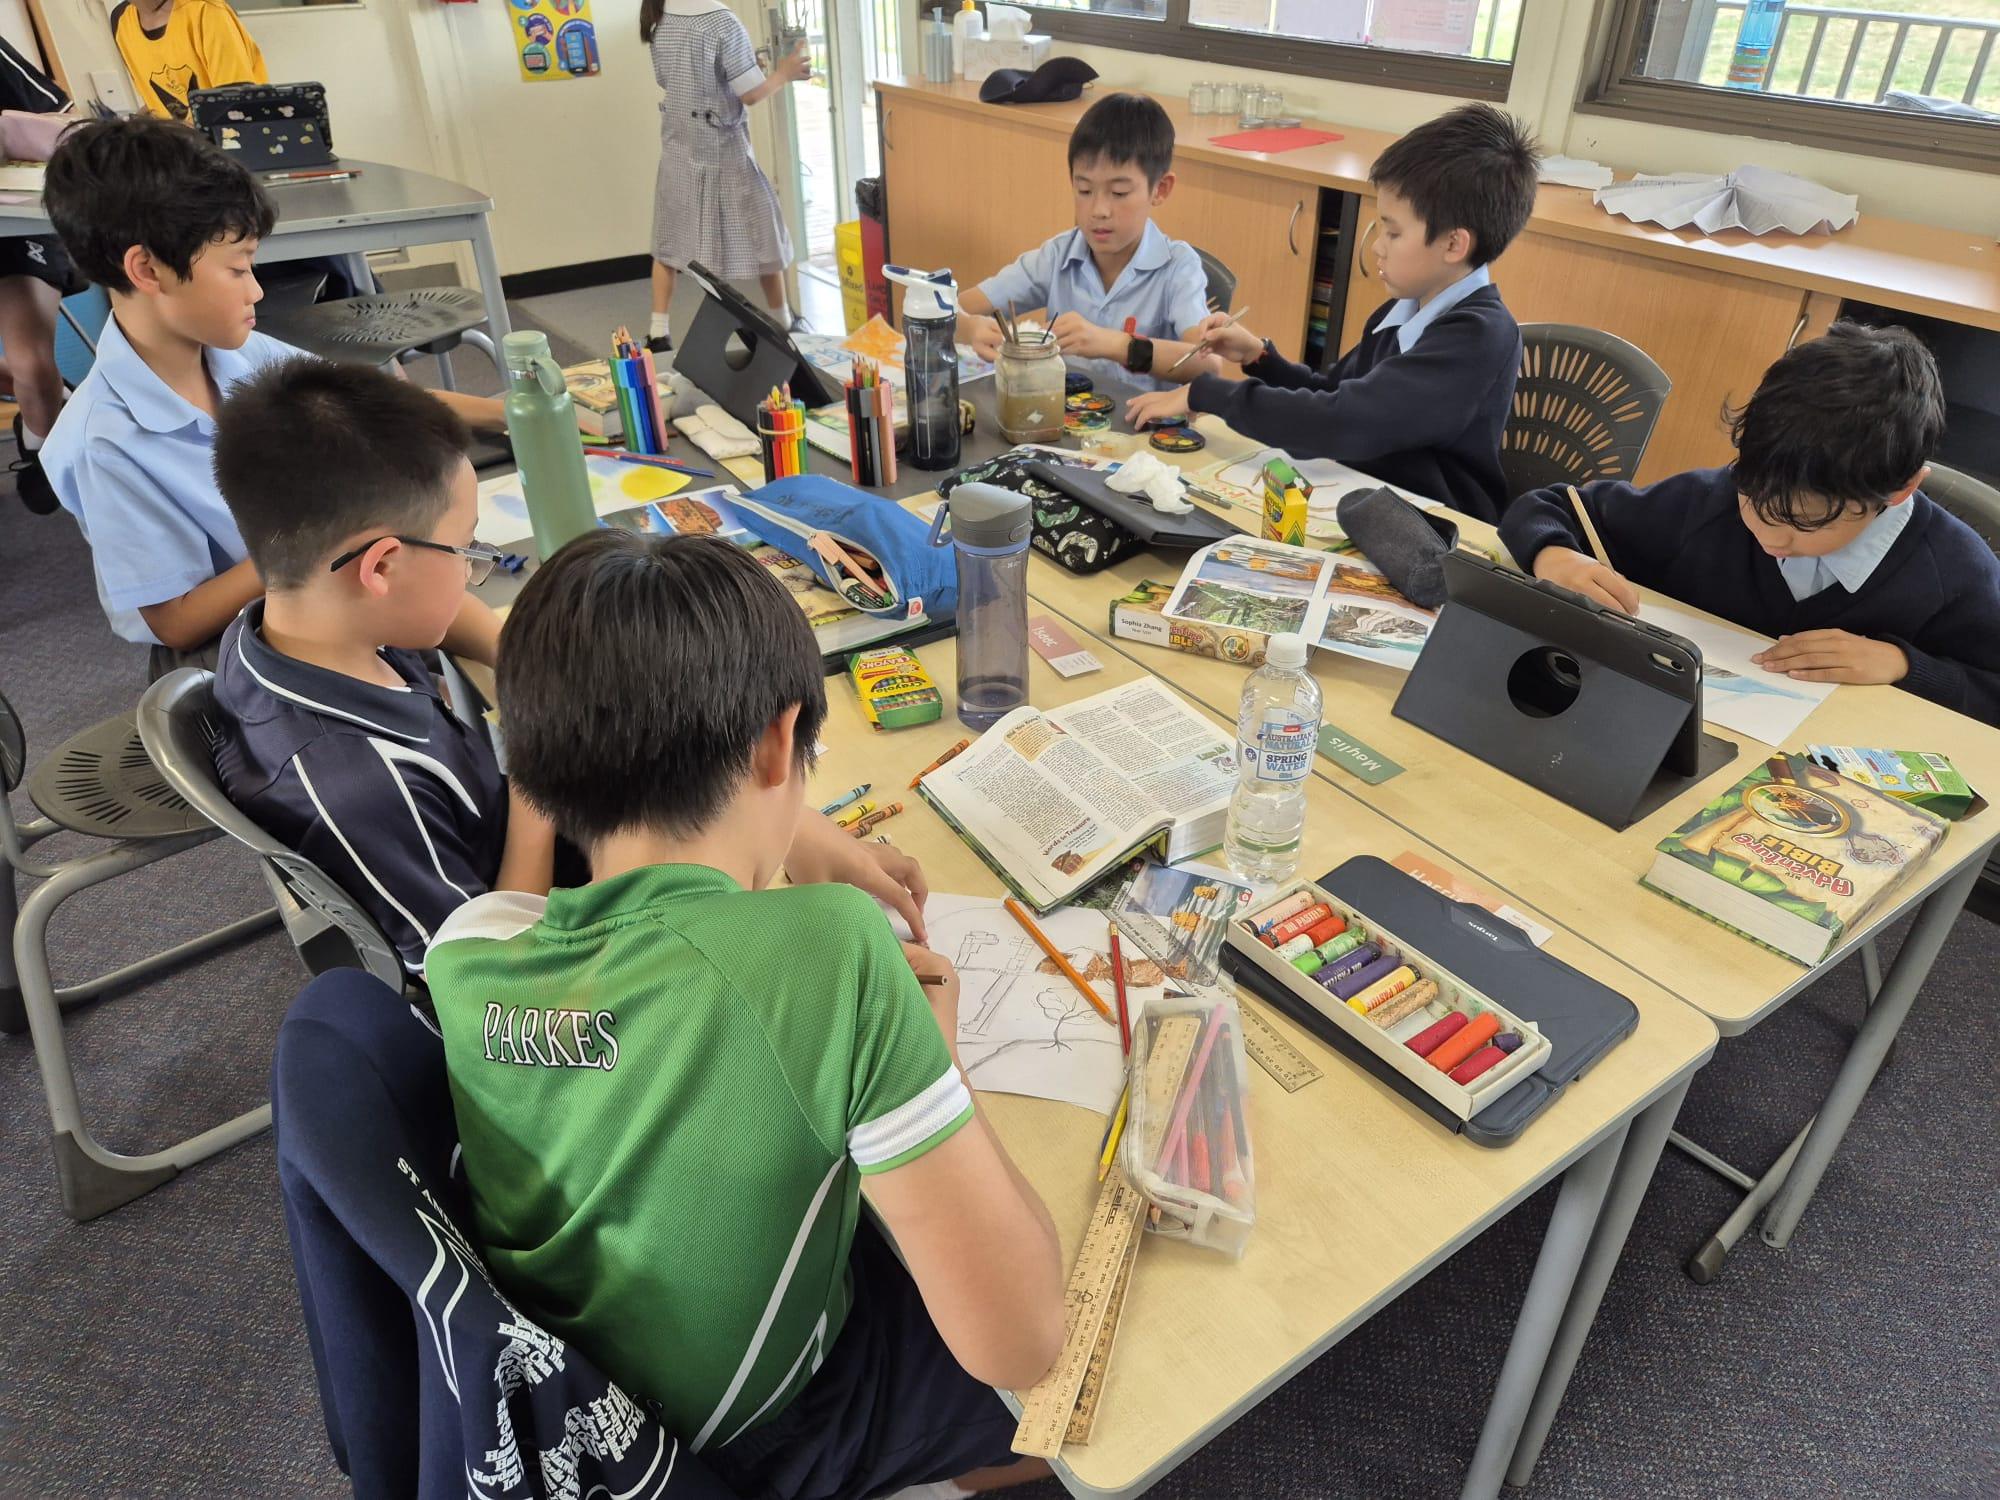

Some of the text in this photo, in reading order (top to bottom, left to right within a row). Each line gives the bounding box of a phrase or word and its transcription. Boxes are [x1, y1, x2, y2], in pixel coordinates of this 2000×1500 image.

[1121, 618, 1142, 629] Sophia
[1143, 622, 1163, 633] Zhang
[1169, 635, 1195, 648] IBLE
[860, 656, 910, 670] CRAYONS
[876, 681, 922, 693] Crayola
[1266, 731, 1312, 742] AUSTRALIAN
[1265, 740, 1311, 750] NATURAL
[1266, 752, 1308, 763] SPRING
[1266, 761, 1306, 772] WATER
[1760, 834, 1844, 877] BIBLE
[1732, 834, 1853, 896] Adventure
[483, 1001, 619, 1071] PARKES
[398, 1156, 421, 1187] ST
[497, 1322, 550, 1356] Elizabeth
[1090, 1370, 1098, 1381] 27
[588, 1397, 612, 1430] Jovial
[1081, 1405, 1089, 1416] 29
[1076, 1423, 1085, 1434] 30
[620, 1429, 632, 1452] Ng
